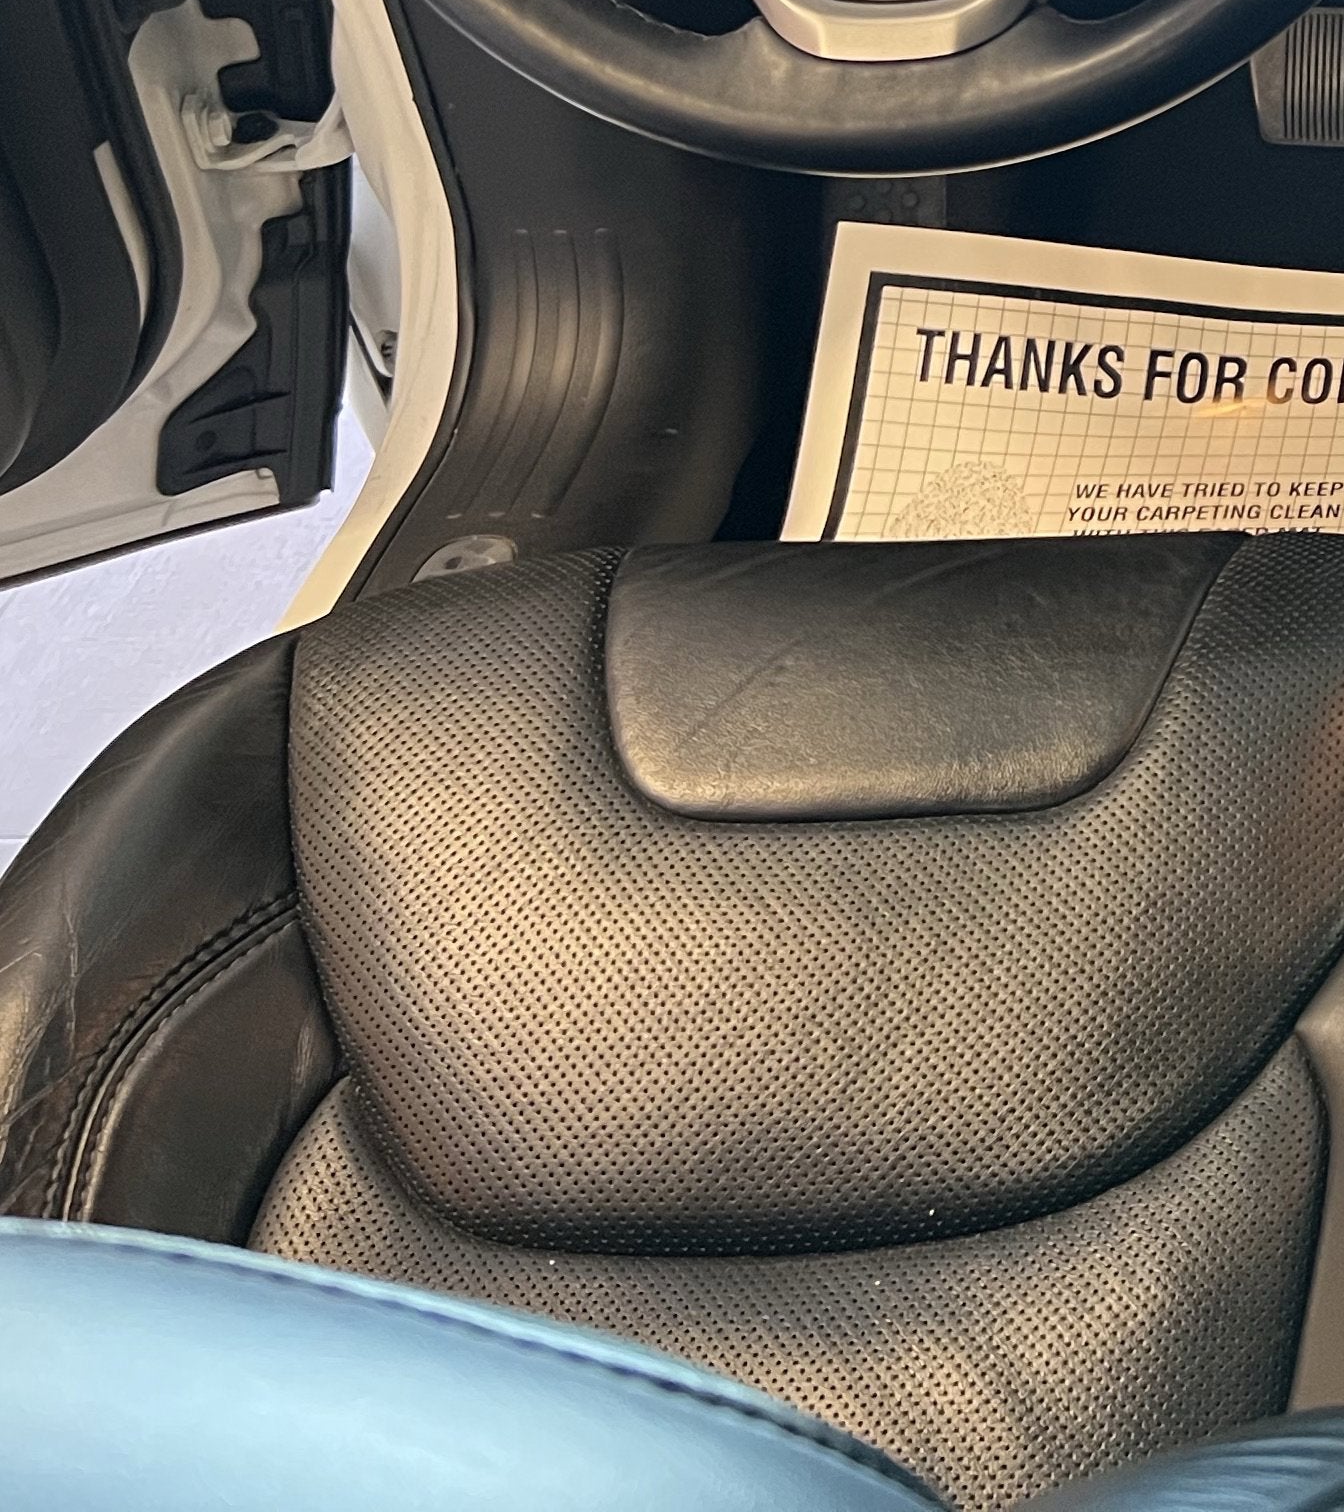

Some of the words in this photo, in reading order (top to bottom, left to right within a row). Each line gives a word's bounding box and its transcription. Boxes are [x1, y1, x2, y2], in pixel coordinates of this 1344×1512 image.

[916, 328, 1125, 399] THANKS
[1143, 349, 1248, 405] FOR
[1075, 483, 1110, 499] WE
[1116, 483, 1174, 499] HAVE
[1182, 482, 1246, 498] TRIED
[1254, 482, 1281, 498] TO
[1288, 481, 1344, 497] KEEP
[1067, 506, 1128, 522] YOUR
[1136, 504, 1261, 521] CARPETING
[1269, 504, 1341, 520] CLEAN
